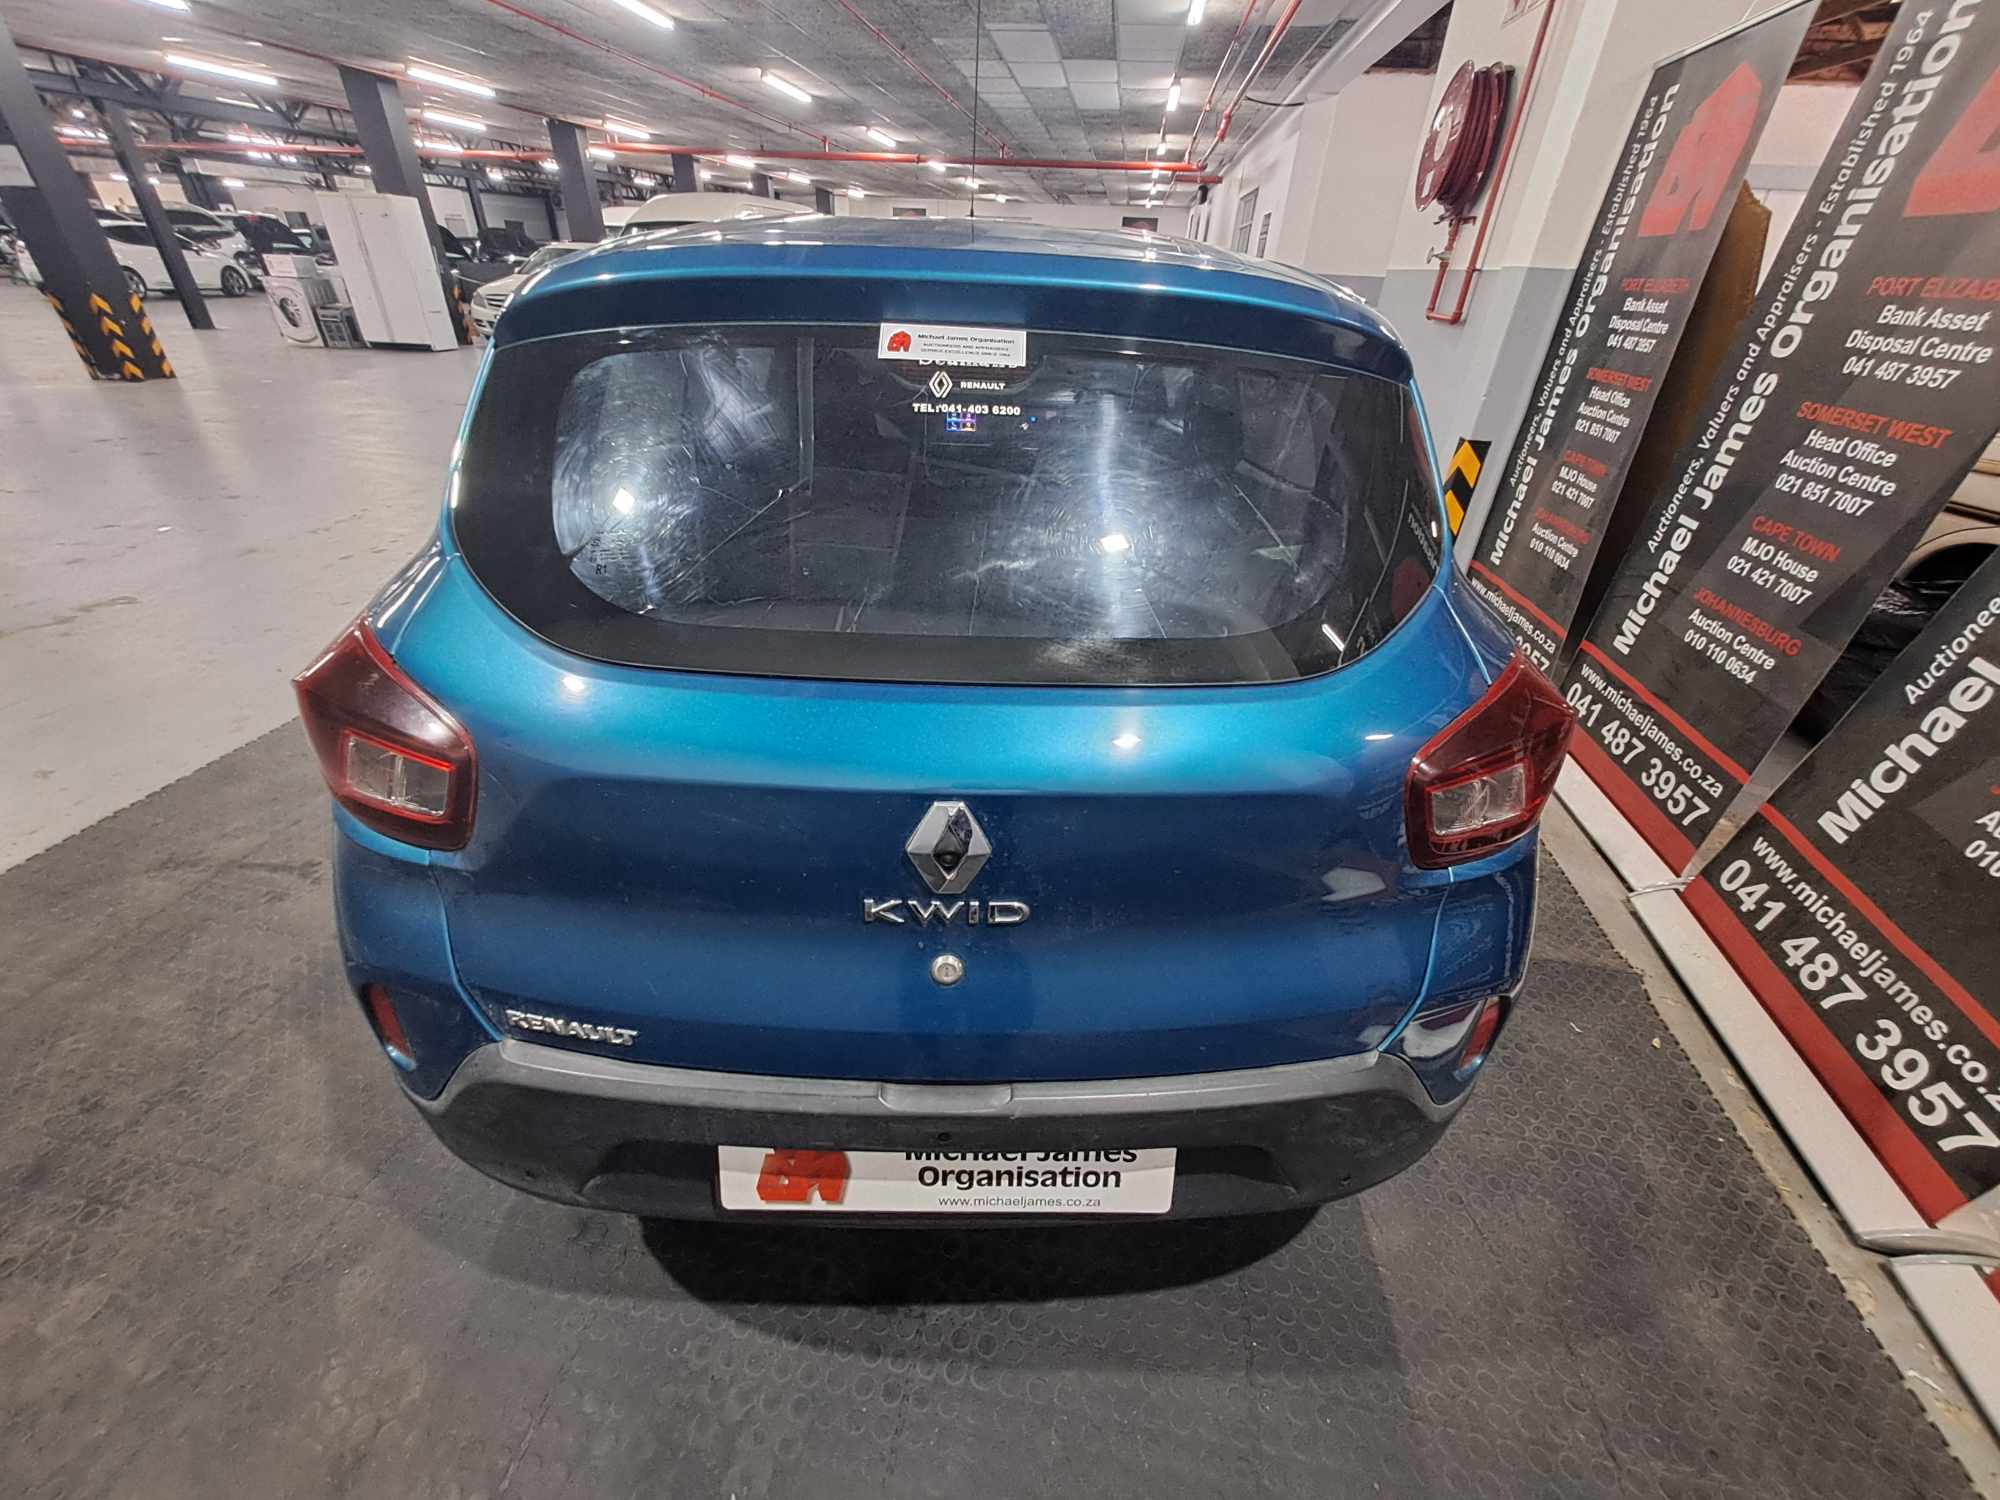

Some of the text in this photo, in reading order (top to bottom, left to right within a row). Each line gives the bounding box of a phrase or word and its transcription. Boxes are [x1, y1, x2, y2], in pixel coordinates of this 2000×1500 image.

[1538, 355, 1561, 408] Valuers
[1559, 328, 1572, 357] and
[1568, 248, 1602, 327] Appraisers
[1602, 143, 1641, 235] Established
[1647, 457, 1704, 552] Auctioneers,
[1697, 384, 1740, 450] Valuers
[1736, 342, 1761, 381] and
[1756, 234, 1818, 341] Appraisers
[1818, 82, 1898, 214] Established
[1889, 9, 1936, 74] 1964
[1866, 276, 1922, 297] PORT
[1623, 297, 1669, 313] Bank Asset
[1876, 304, 1992, 332] Bank Asset
[1490, 456, 1538, 566] Michael
[1537, 349, 1578, 451] James
[1576, 83, 1680, 338] Organisation
[1607, 334, 1623, 348] 041
[1608, 315, 1669, 334] Disposal Centre
[1612, 0, 1981, 655] Michael James Organisation
[1845, 329, 1993, 364] Disposal Centre
[960, 381, 1006, 391] RENAULT
[1842, 356, 1962, 389] 041 487 3957
[992, 405, 1021, 415] 6200
[1589, 386, 1612, 402] Head
[1577, 402, 1630, 428] Auction Centre
[1796, 401, 1952, 448] SOMERSET WEST
[1804, 428, 1898, 468] Head Office
[1576, 473, 1598, 492] House
[1779, 449, 1897, 497] Auction Centre
[1775, 473, 1874, 517] 021 851 7007
[1532, 522, 1558, 544] Auction
[1751, 515, 1841, 561] CAPE TOWN
[1741, 536, 1819, 583] MJO House
[1727, 555, 1812, 605] 021 421 7007
[1683, 629, 1757, 685] 010 110 0634
[1688, 608, 1776, 670] Auction Centre
[1581, 662, 1724, 799] www.michaeljames.co.za
[1566, 682, 1604, 728] 041
[1601, 719, 1646, 765] 487
[1641, 758, 1711, 827] 3957
[863, 898, 1031, 926] KWID
[1719, 859, 2000, 1152] 041 487 3957
[505, 1009, 640, 1046] RENAULT
[918, 1165, 1122, 1190] Organisation
[938, 1196, 1102, 1209] www.michaeljames.co.za
